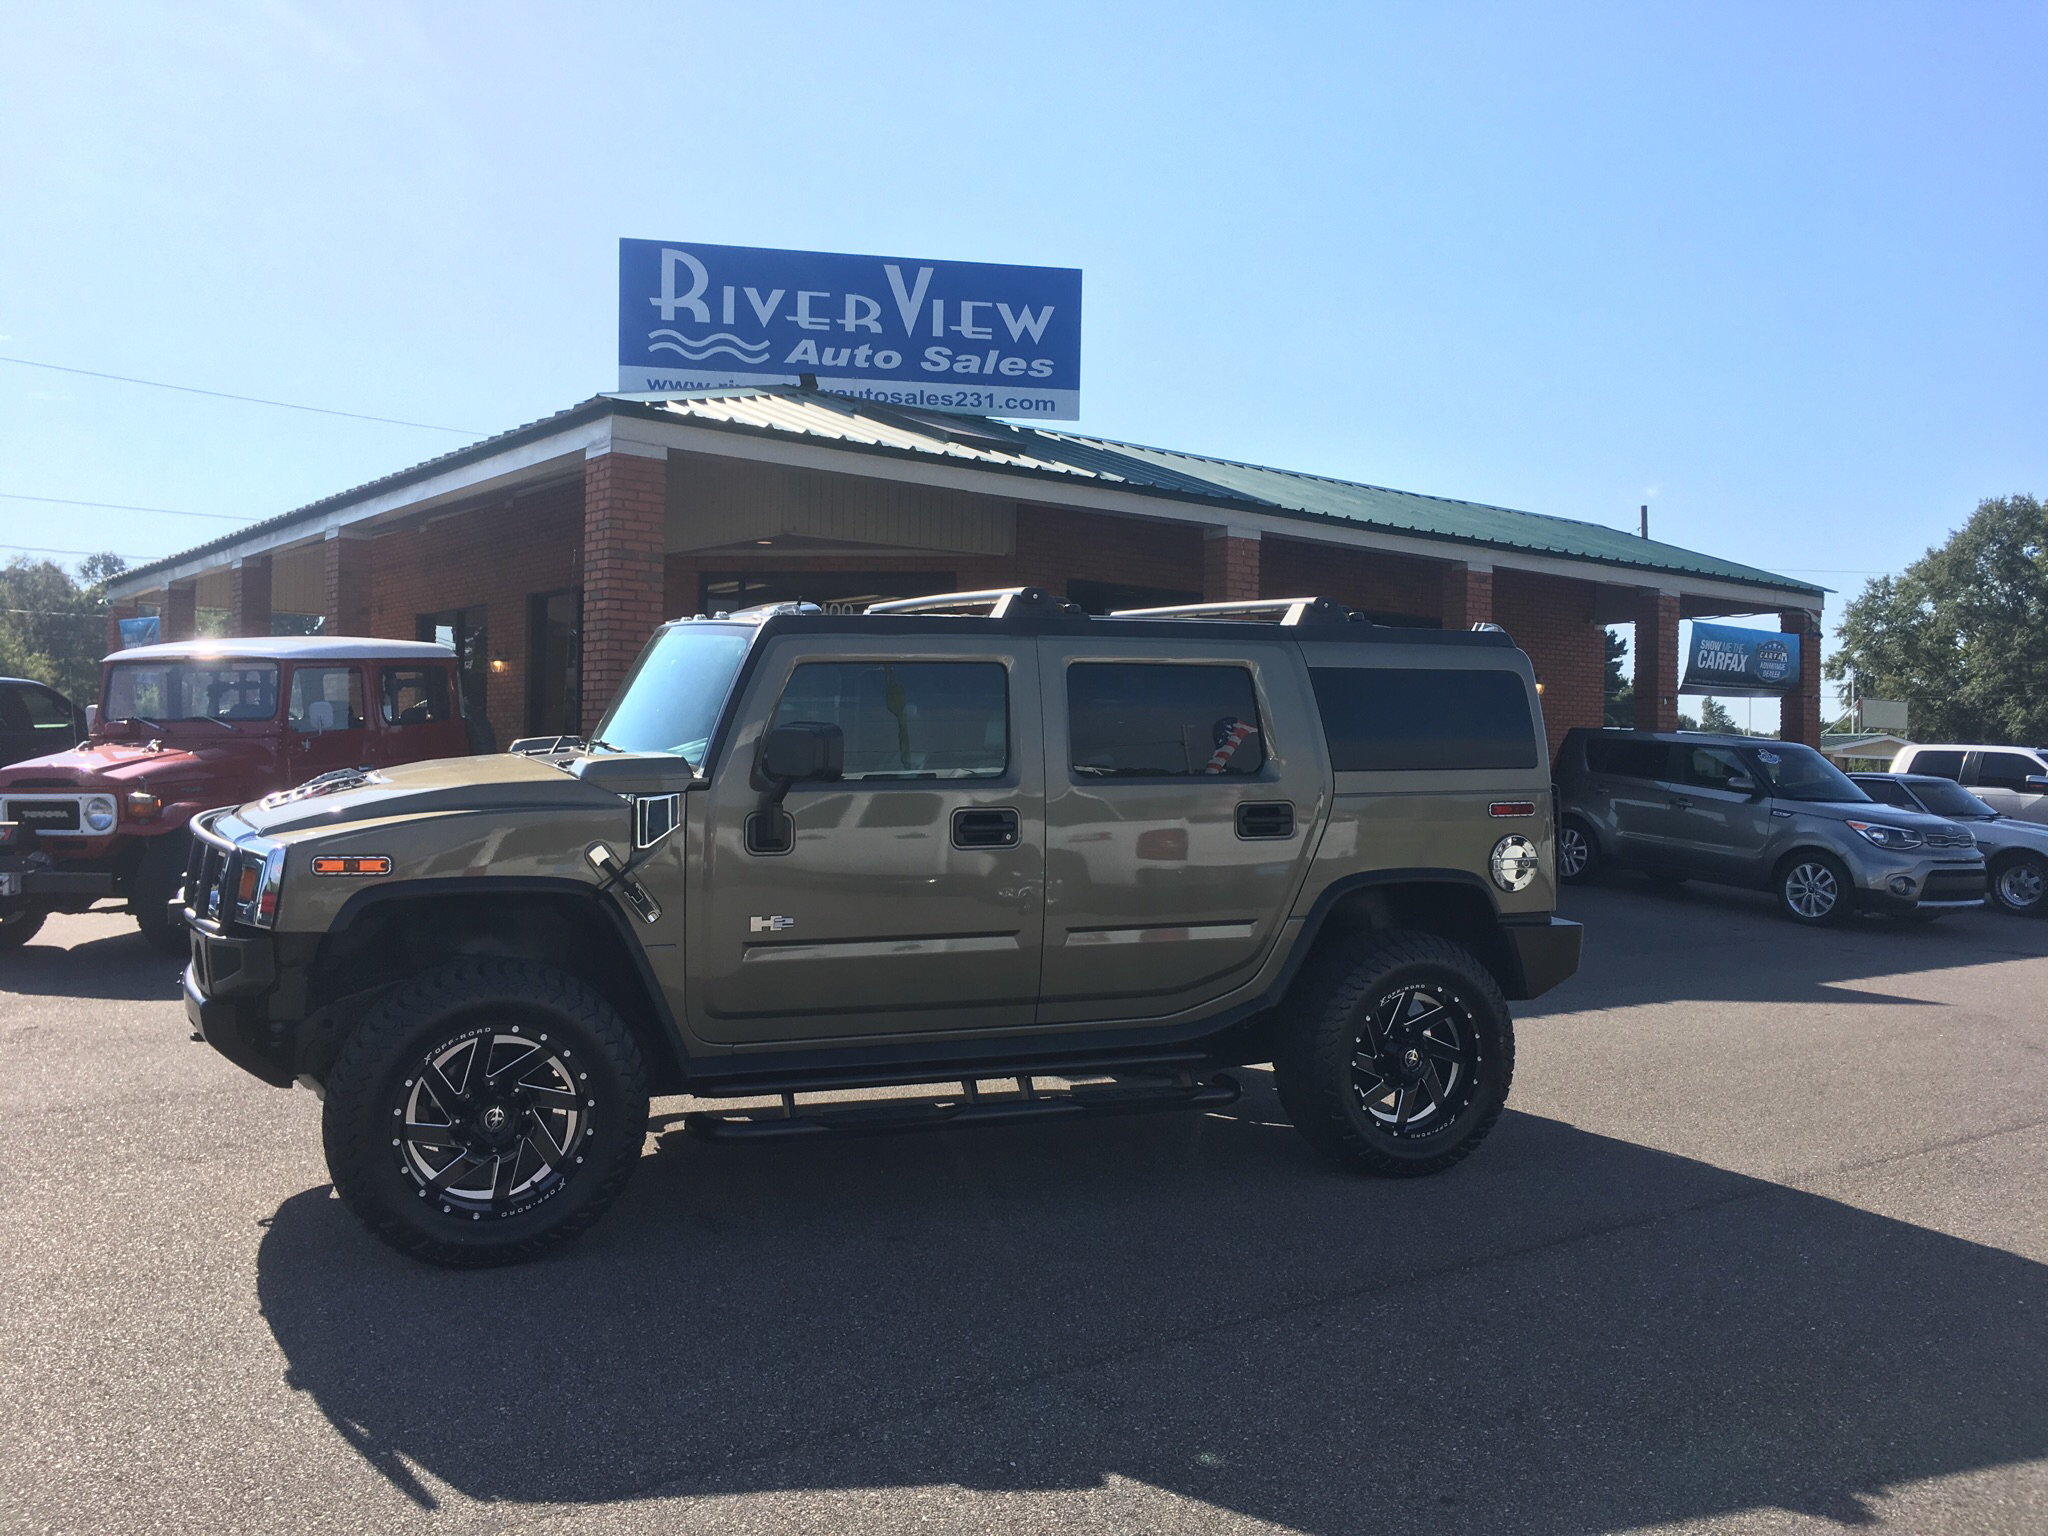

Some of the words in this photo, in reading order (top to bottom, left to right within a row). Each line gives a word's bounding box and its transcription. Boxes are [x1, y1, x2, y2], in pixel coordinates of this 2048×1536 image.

[784, 339, 902, 370] Auto
[920, 346, 1054, 378] Sales
[1700, 639, 1722, 651] SHOW
[1721, 642, 1733, 653] ME
[1733, 642, 1745, 654] THE
[1697, 650, 1749, 673] CARFAX
[434, 1027, 491, 1054] OFF-ROAD
